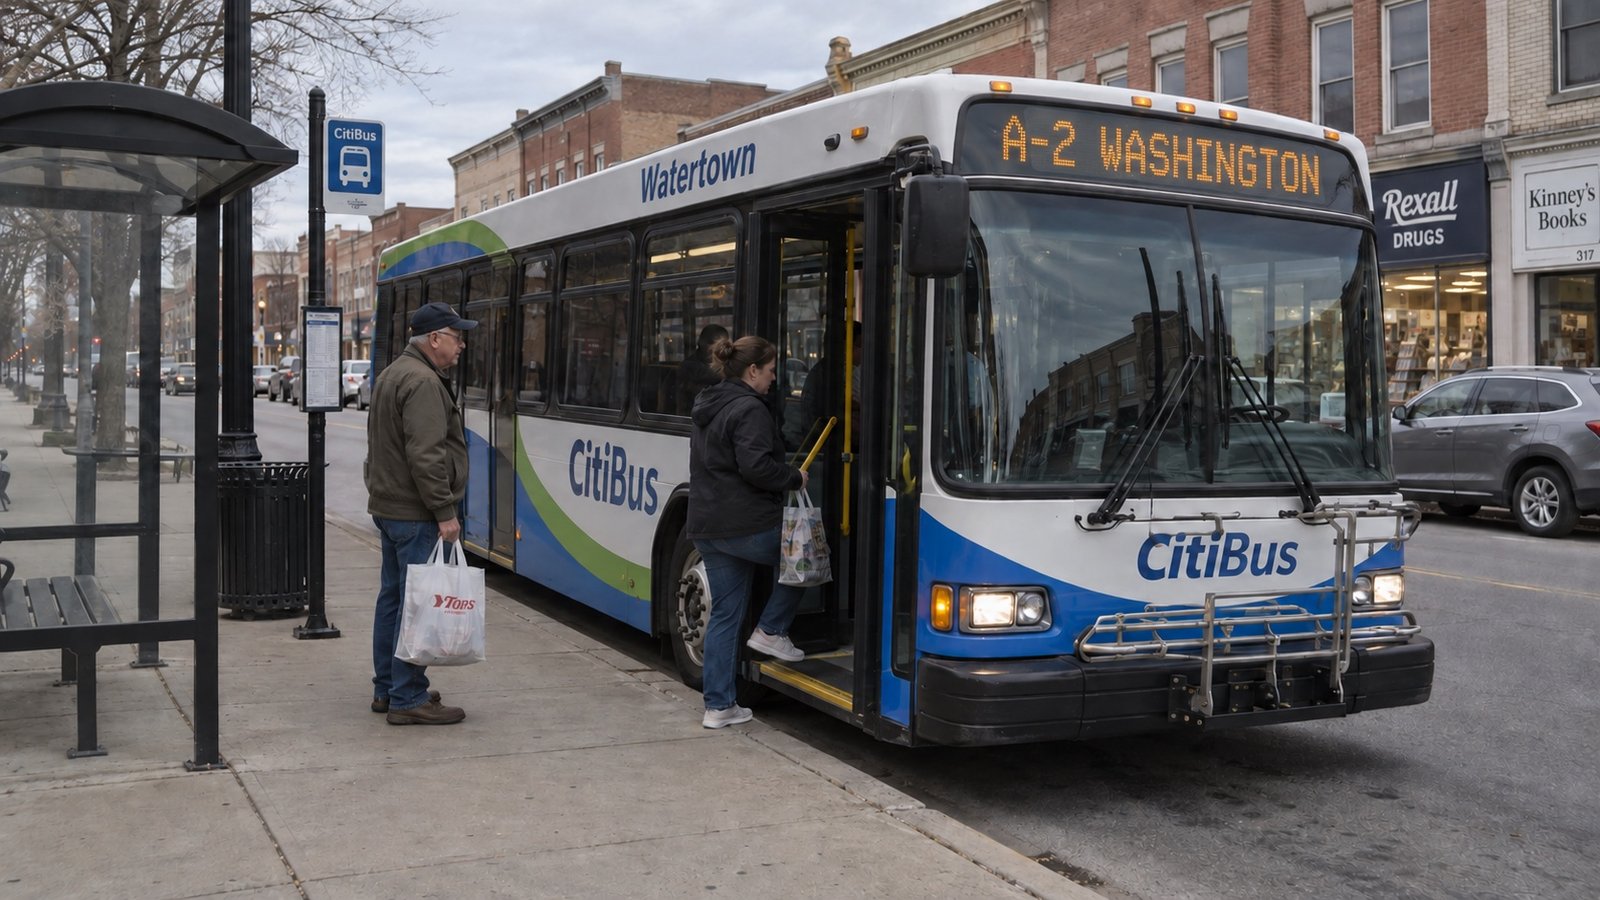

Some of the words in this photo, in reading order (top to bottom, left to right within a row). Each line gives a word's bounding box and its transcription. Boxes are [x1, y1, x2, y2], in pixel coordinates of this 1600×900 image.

[334, 127, 377, 141] CitiBus
[641, 142, 756, 204] Watertown
[1002, 114, 1076, 168] A-2
[1100, 125, 1320, 196] WASHINGTON
[1382, 179, 1458, 227] Rexall
[1529, 182, 1596, 209] Kinney's
[1538, 208, 1587, 231] Books
[1393, 228, 1444, 249] DRUGS
[1576, 249, 1595, 262] 317
[569, 438, 659, 516] CitiBus
[1137, 532, 1299, 581] CitiBus
